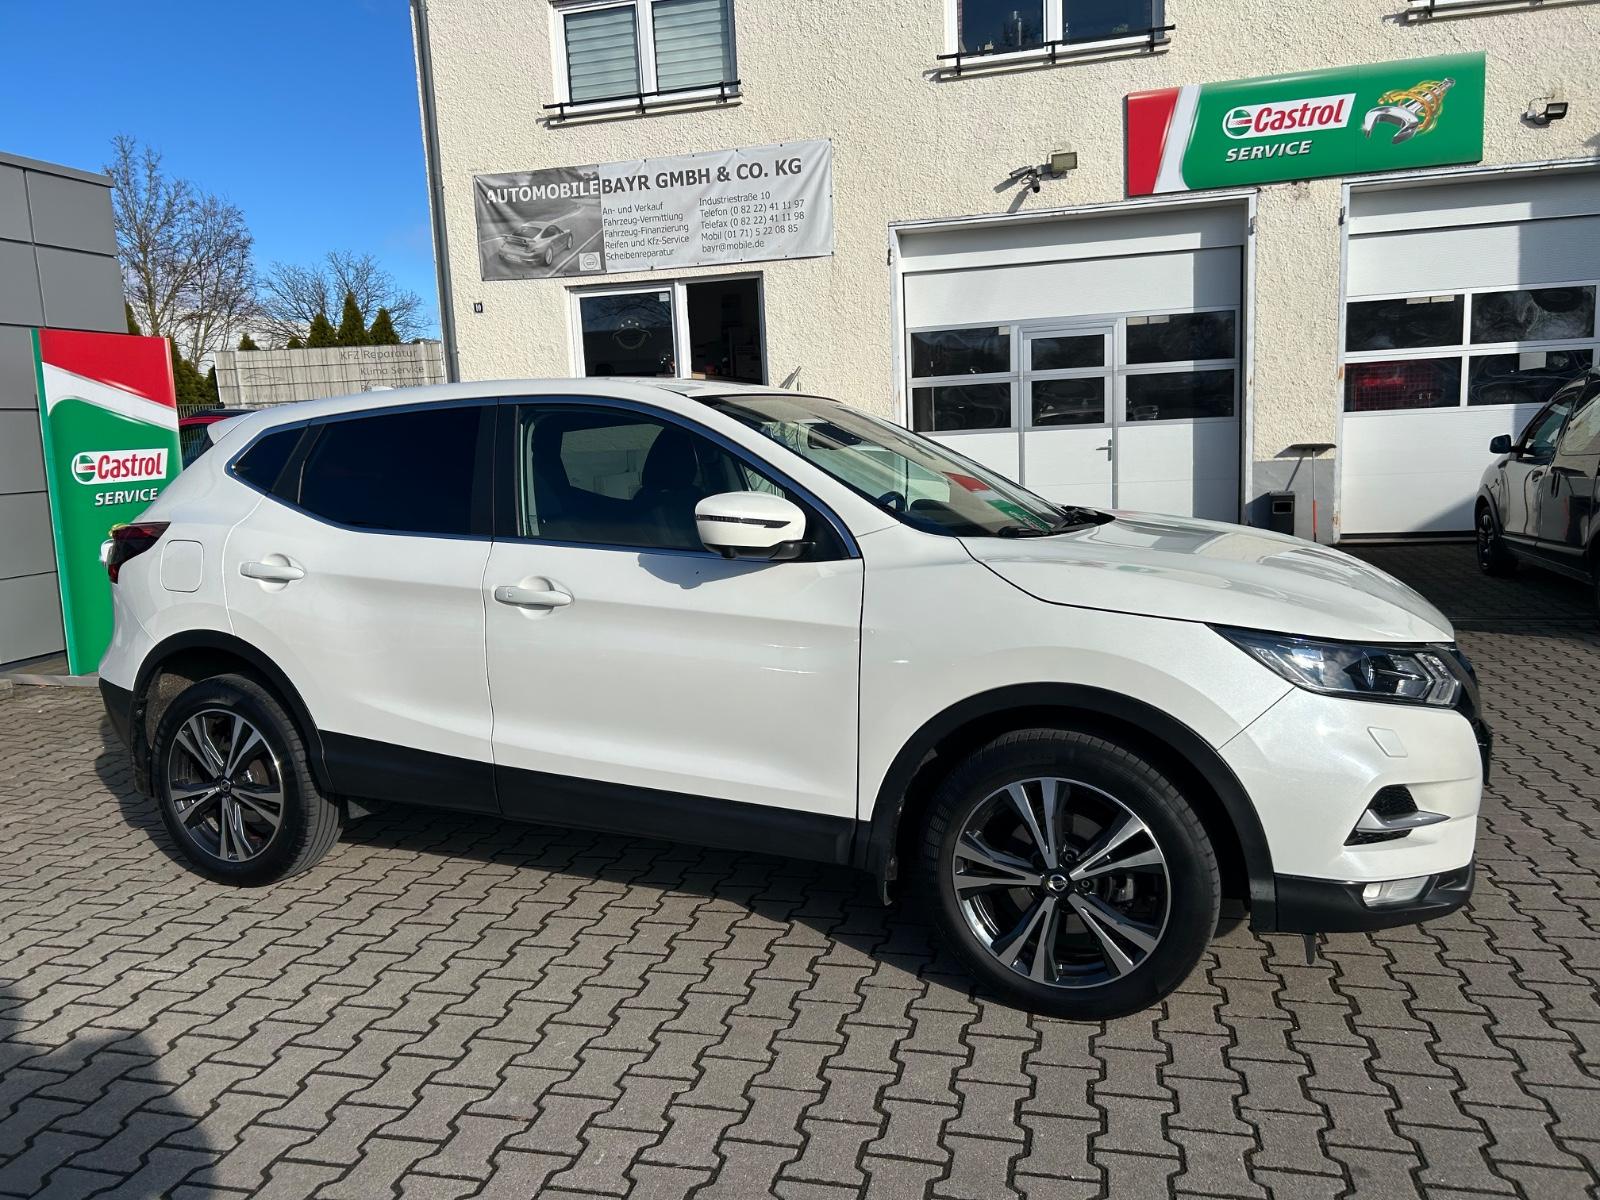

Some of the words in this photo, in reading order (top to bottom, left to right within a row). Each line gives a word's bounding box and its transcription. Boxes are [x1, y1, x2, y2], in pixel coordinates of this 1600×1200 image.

[1253, 98, 1345, 133] Castrol
[1225, 140, 1313, 162] SERVICE
[486, 180, 599, 204] AUTOMOBILE
[602, 174, 651, 194] BAYR
[655, 167, 711, 189] GMBH
[716, 166, 732, 182] &
[736, 162, 769, 180] CO.
[775, 158, 802, 176] KG
[699, 192, 758, 207] Industriestraße
[760, 191, 771, 200] 10
[602, 207, 615, 215] An-
[617, 204, 632, 213] und
[634, 201, 664, 212] Verkauf
[700, 207, 728, 218] Telefon
[730, 206, 739, 216] (0
[740, 205, 751, 213] 82
[753, 203, 767, 213] 22)
[769, 202, 779, 211] 41
[782, 201, 791, 209] 11
[794, 199, 805, 208] 97
[603, 212, 684, 227] Fahrzeug-Vermittlung
[700, 219, 728, 230] Telefax
[730, 218, 739, 229] (0
[740, 217, 751, 225] 82
[753, 215, 767, 225] 22)
[769, 214, 779, 222] 41
[782, 213, 791, 221] 11
[794, 211, 805, 220] 98
[604, 223, 689, 238] Fahrzeug-Finanzierung
[701, 231, 722, 241] Mobil
[724, 229, 737, 240] (01
[740, 228, 753, 238] 71)
[755, 228, 761, 236] 5
[763, 226, 773, 235] 22
[775, 225, 786, 234] 08
[787, 224, 799, 233] 85
[605, 240, 629, 250] Reifen
[631, 239, 645, 248] und
[647, 235, 690, 246] Kfz-Service
[702, 240, 765, 254] bayr@mobile.de
[605, 248, 675, 261] Scheibenreparatur
[340, 350, 360, 361] KFZ
[363, 348, 417, 361] Reparatur
[360, 367, 388, 376] Klima
[391, 365, 424, 375] Service
[97, 452, 162, 480] Castrol
[94, 487, 158, 506] SERVICE
